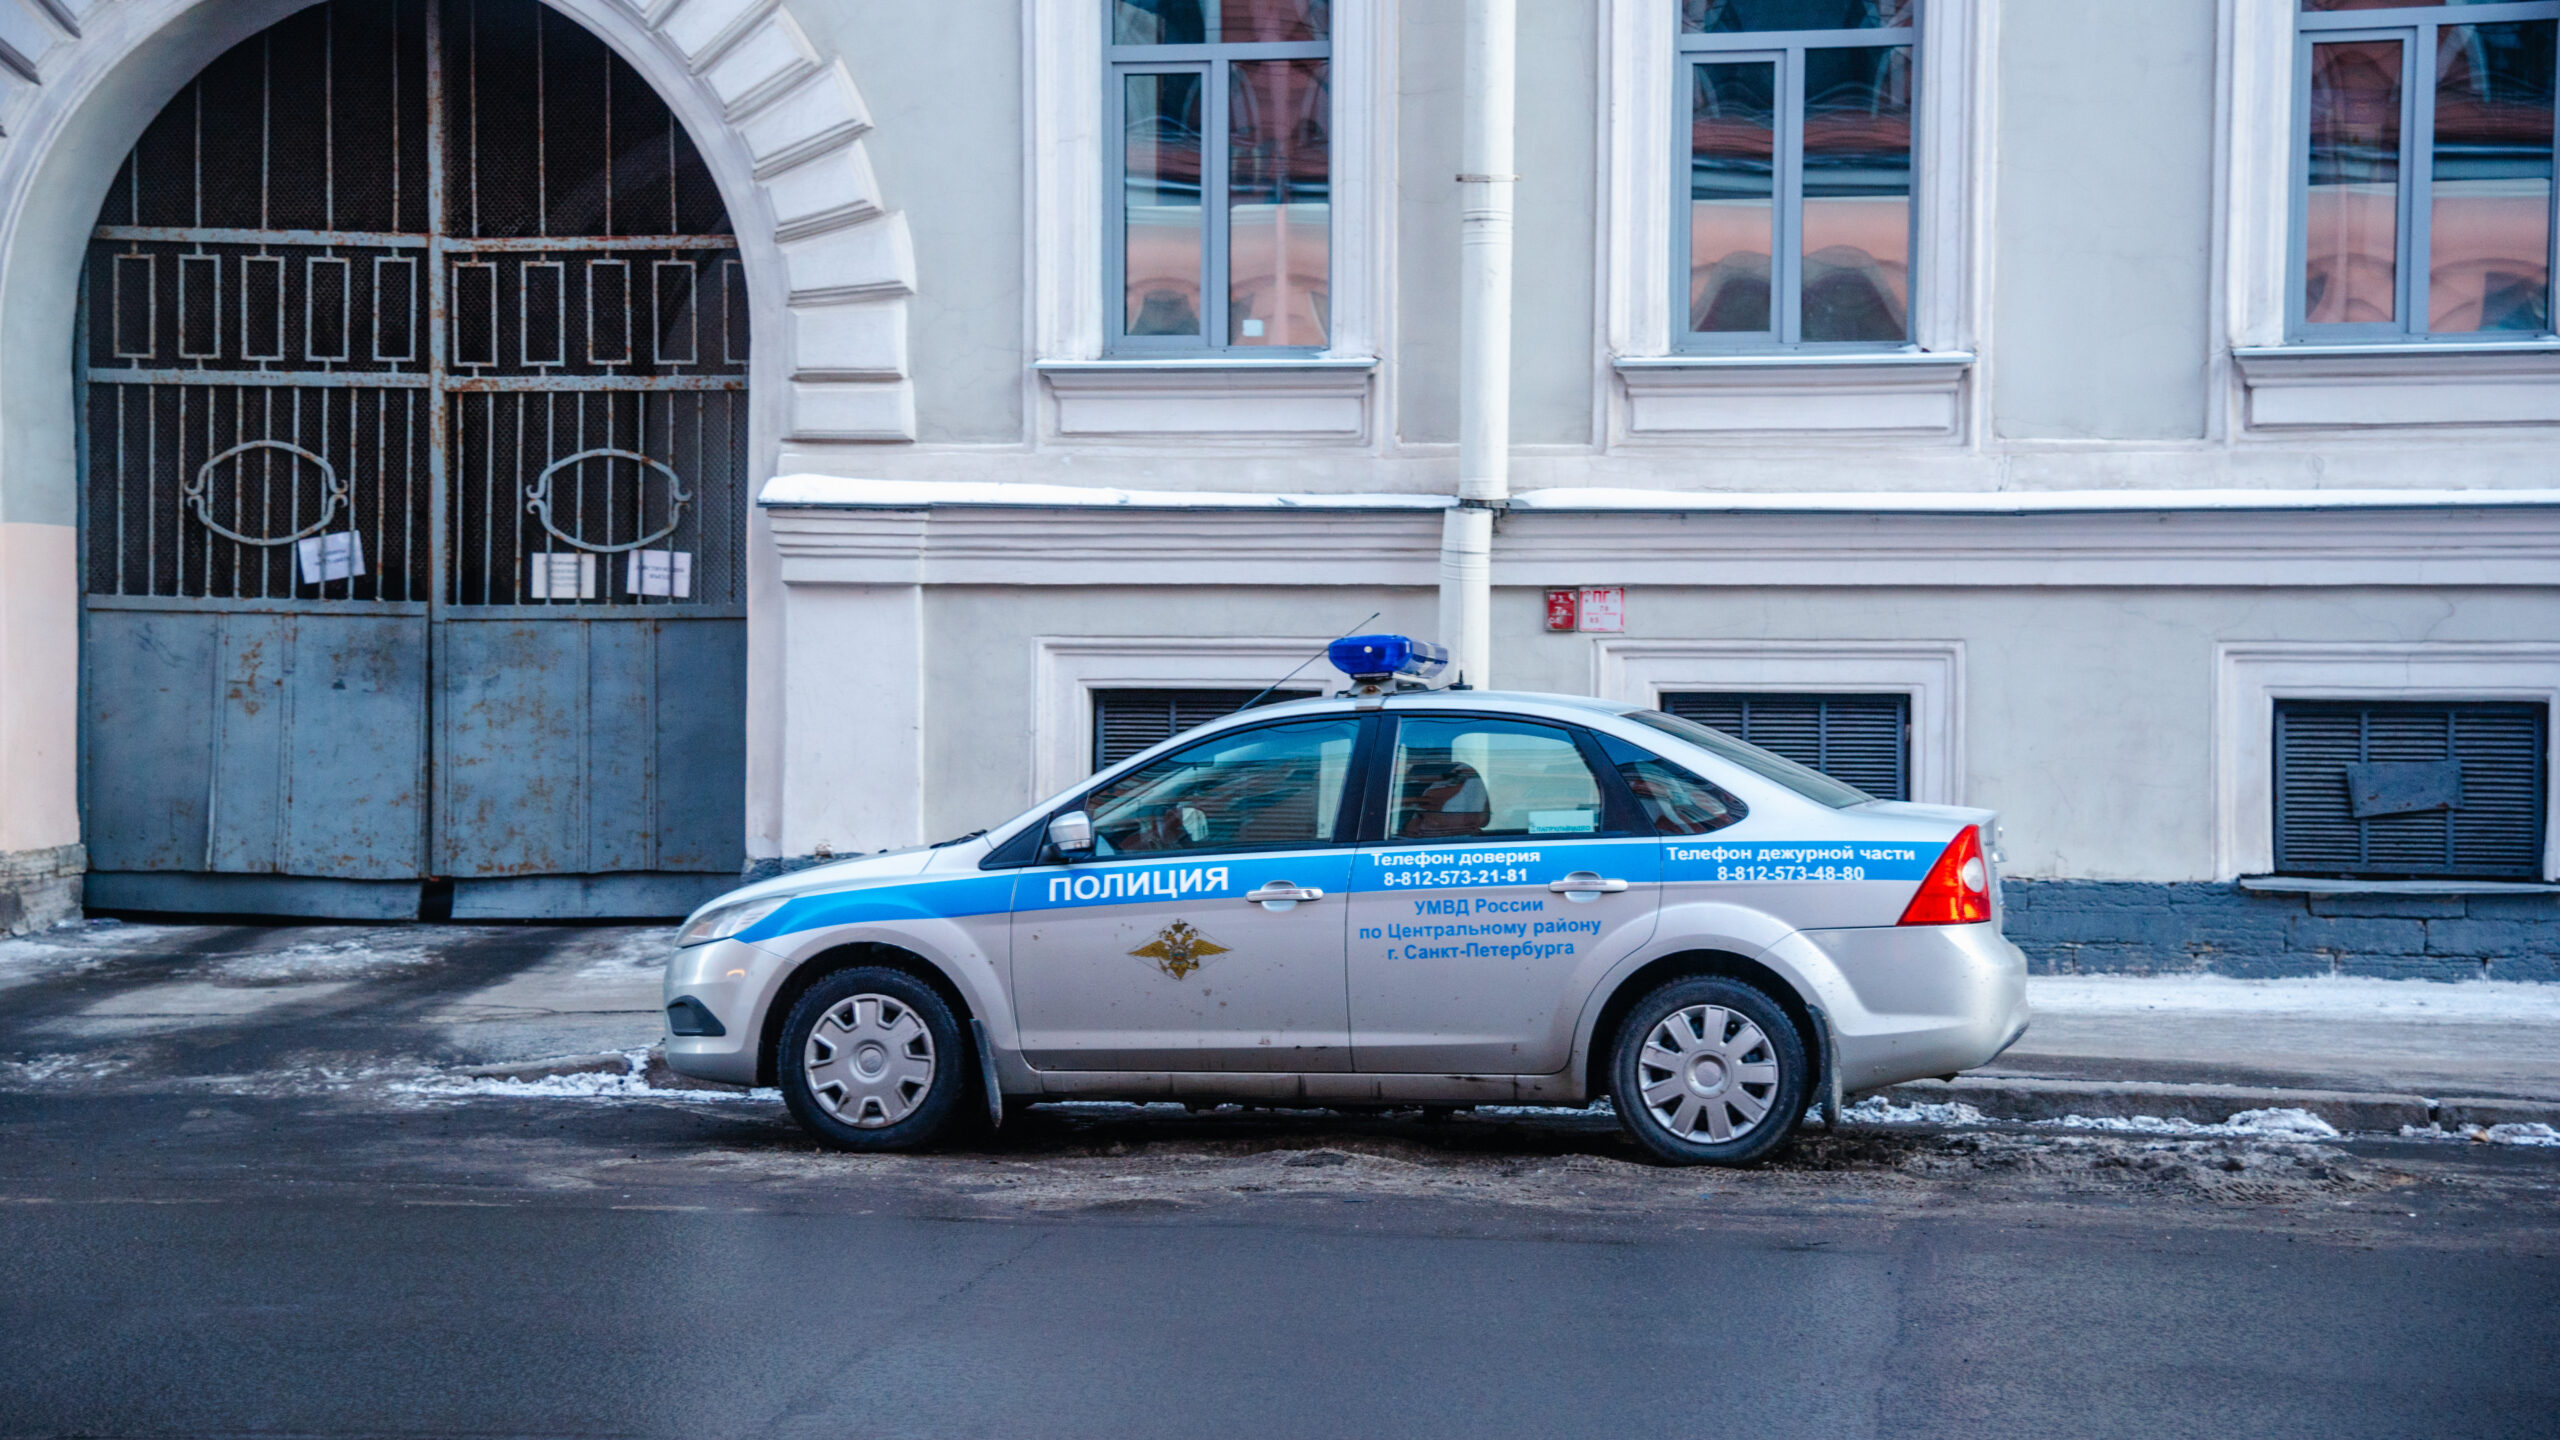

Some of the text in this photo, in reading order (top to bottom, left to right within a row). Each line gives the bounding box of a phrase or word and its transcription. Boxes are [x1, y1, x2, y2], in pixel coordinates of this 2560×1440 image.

[1371, 851, 1541, 868] Телефон доверия
[1666, 846, 1916, 863] Телефон дежурной части
[1383, 868, 1528, 886] 8-812-573-21-81
[1717, 866, 1865, 881] 8-812-573-48-80
[1049, 866, 1229, 902] ПОЛИЦИЯ
[1414, 898, 1544, 917] УМВД России
[1359, 917, 1602, 940] по Центральному району
[1388, 941, 1575, 960] г. Санкт-Петербурга
